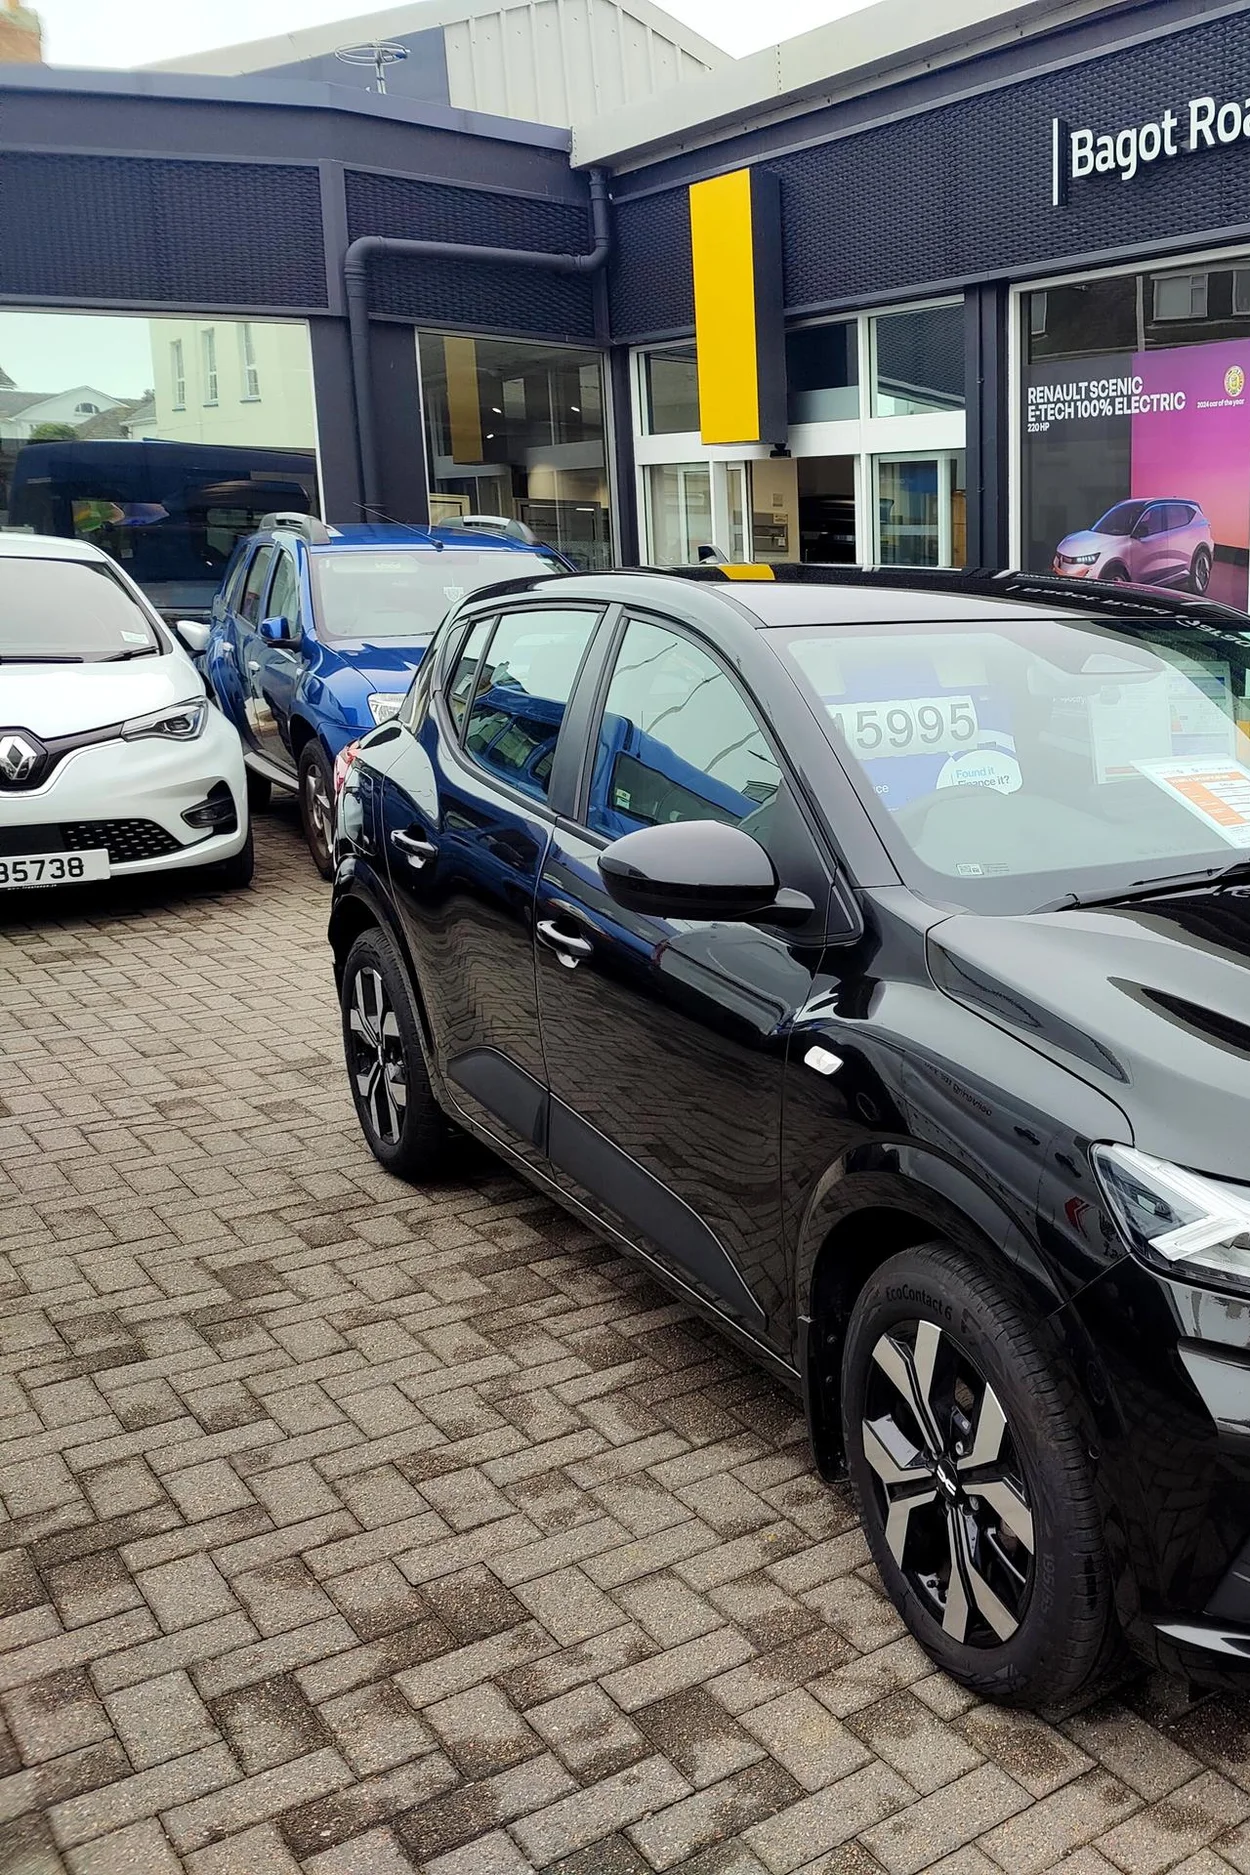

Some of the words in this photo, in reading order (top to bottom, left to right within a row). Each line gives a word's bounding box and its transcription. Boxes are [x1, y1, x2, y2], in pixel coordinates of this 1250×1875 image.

[1070, 108, 1178, 181] Bagot
[1027, 382, 1089, 404] RENAULT
[1090, 376, 1143, 399] SCENIC
[1027, 400, 1075, 423] E-TECH
[1076, 398, 1113, 419] 100%
[1115, 391, 1186, 416] ELECTRIC
[1027, 423, 1039, 433] 220
[1040, 422, 1050, 432] HP
[956, 768, 986, 779] Found
[988, 766, 995, 775] it
[997, 774, 1009, 785] it?
[885, 1283, 944, 1316] EcoContact
[943, 1306, 953, 1322] 6
